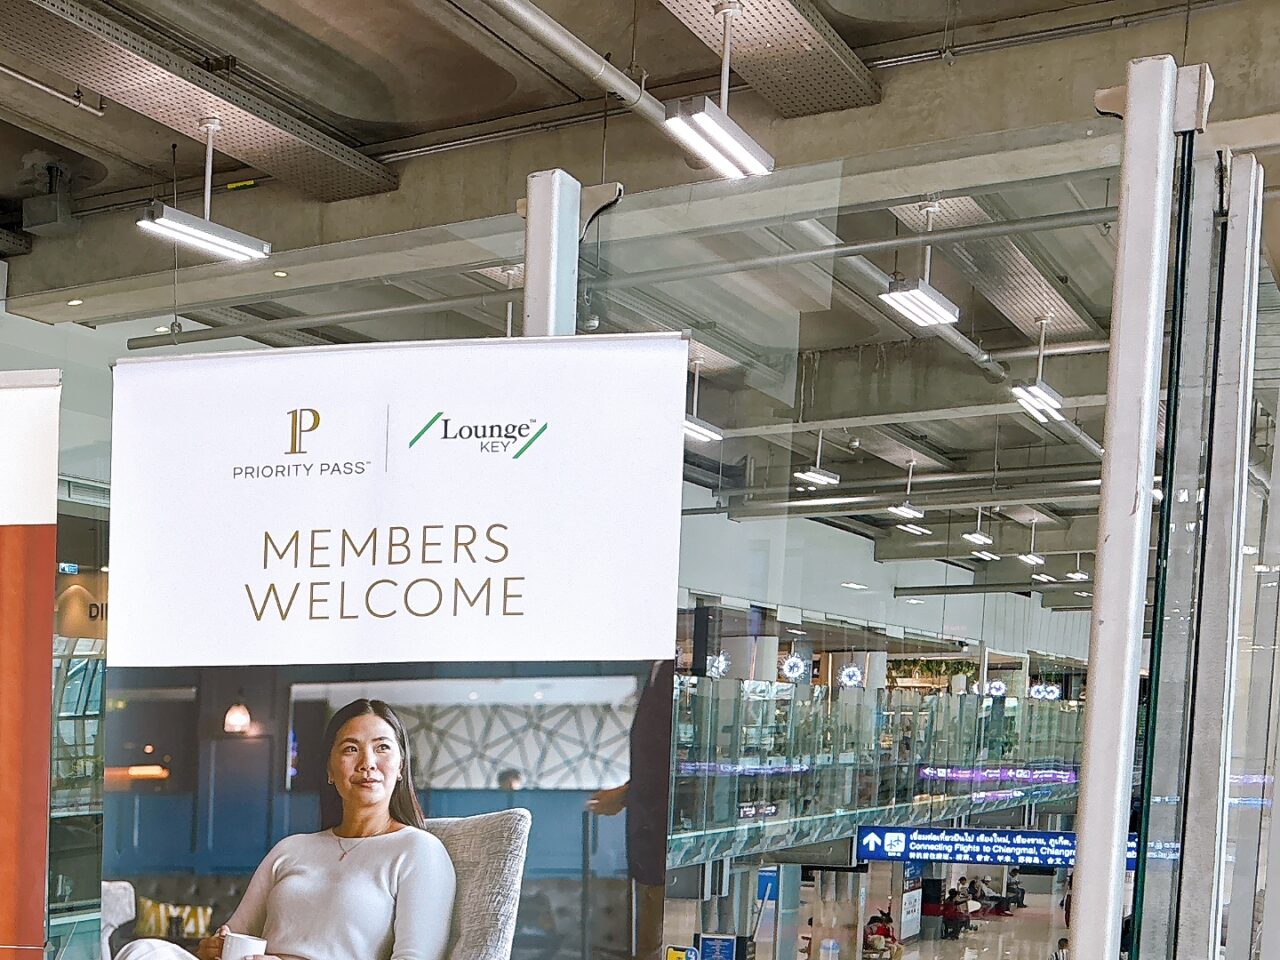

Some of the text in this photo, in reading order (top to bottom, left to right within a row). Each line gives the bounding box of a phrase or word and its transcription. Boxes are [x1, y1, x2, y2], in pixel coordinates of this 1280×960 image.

[480, 440, 510, 452] KEY
[233, 463, 313, 479] PRIORITY
[263, 523, 508, 569] MEMBERS
[244, 576, 525, 621] WELCOME
[909, 841, 952, 854] Connecting
[954, 843, 982, 855] Flights
[982, 845, 991, 855] to
